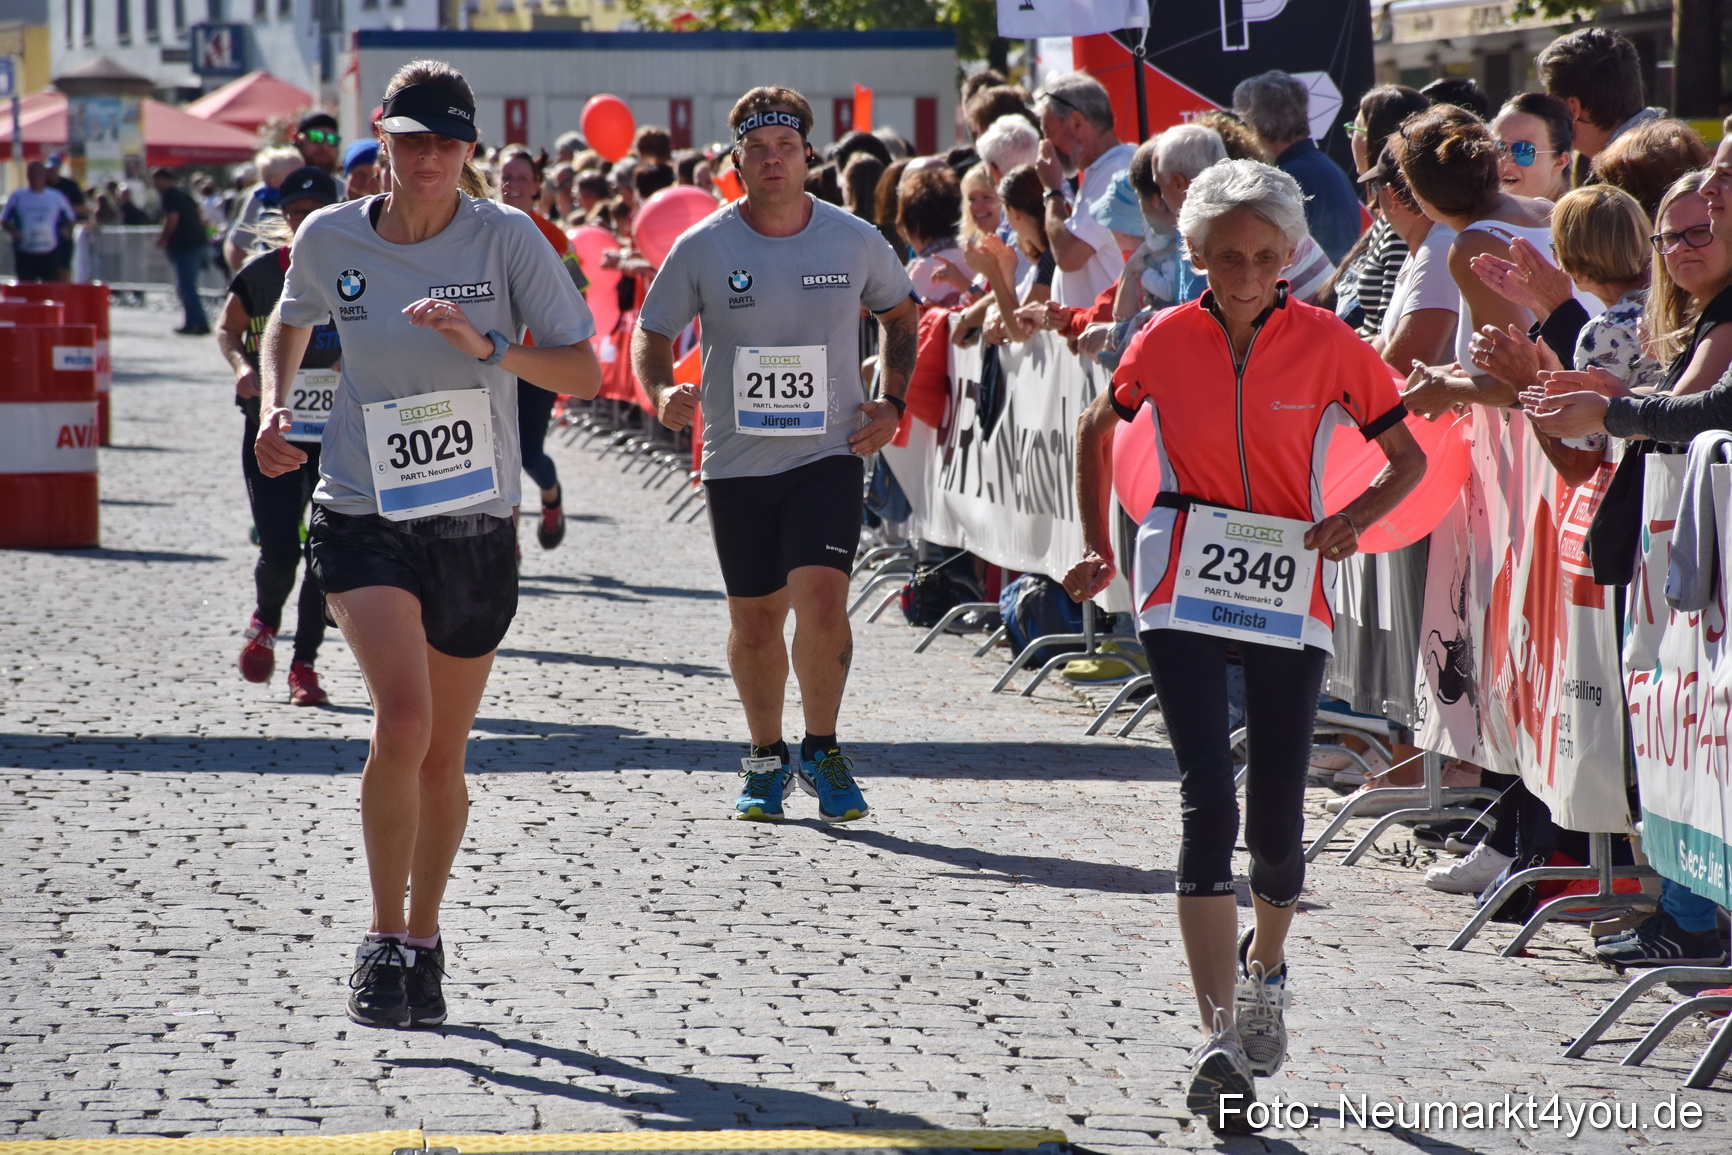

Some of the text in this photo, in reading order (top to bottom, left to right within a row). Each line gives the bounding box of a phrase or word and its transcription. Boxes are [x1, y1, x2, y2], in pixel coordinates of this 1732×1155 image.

[447, 106, 471, 120] 2XU
[738, 111, 800, 135] adidas
[802, 273, 850, 286] BOCK
[430, 281, 494, 299] BOCK
[474, 296, 496, 305] concepts
[729, 295, 755, 304] PARTL
[729, 302, 756, 310] Neumarkt
[339, 305, 368, 316] PARTL
[340, 314, 368, 322] Neumarkt
[760, 355, 801, 365] BOCK
[746, 372, 814, 399] 2133
[293, 389, 338, 411] 228
[399, 400, 452, 421] BOCK
[761, 415, 800, 429] Jürgen
[387, 420, 473, 469] 3029
[400, 463, 463, 481] PARTL Neumarkt
[1226, 522, 1284, 543] BOCK
[1198, 543, 1296, 593] 2349
[1204, 586, 1272, 605] PARTL Neumarkt
[1211, 605, 1267, 630] Christa
